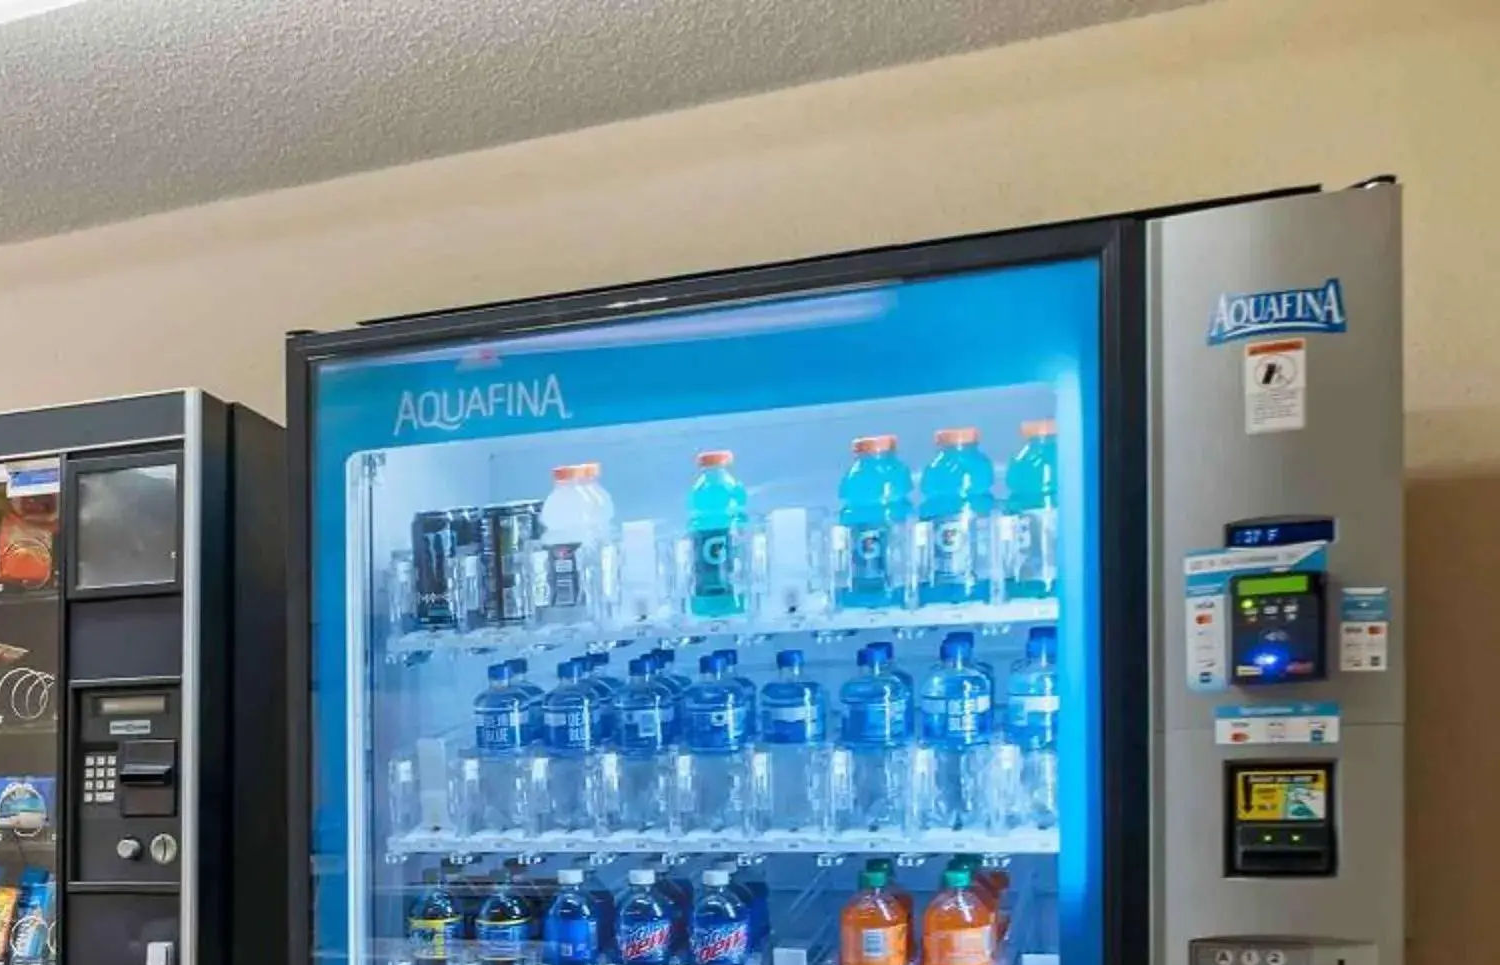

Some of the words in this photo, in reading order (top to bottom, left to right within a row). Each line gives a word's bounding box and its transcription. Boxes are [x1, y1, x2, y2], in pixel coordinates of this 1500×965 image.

[1209, 281, 1347, 337] AQUAFINA
[393, 373, 574, 436] AQUAFINA
[703, 535, 727, 565] G
